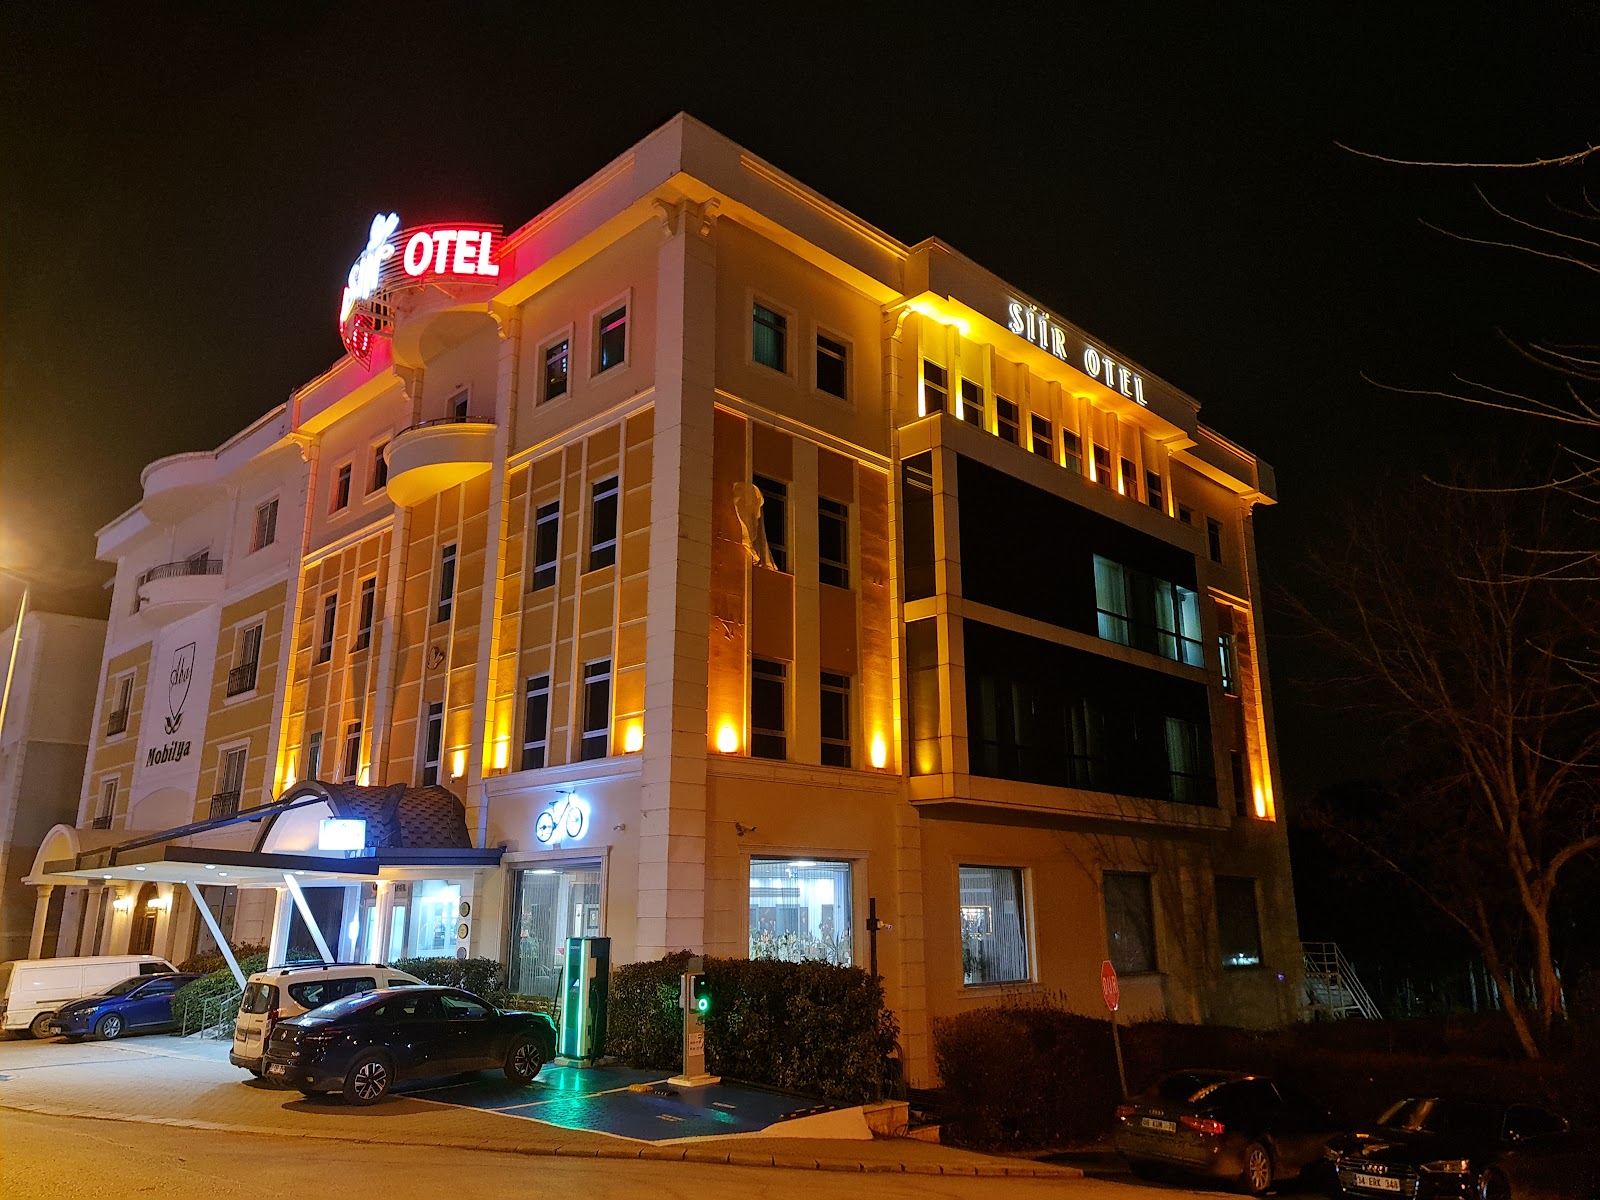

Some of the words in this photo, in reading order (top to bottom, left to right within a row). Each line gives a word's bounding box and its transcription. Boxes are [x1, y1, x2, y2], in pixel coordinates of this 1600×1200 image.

[404, 230, 499, 276] OTEL
[1084, 347, 1148, 407] OTEL
[146, 741, 191, 767] Mobilya
